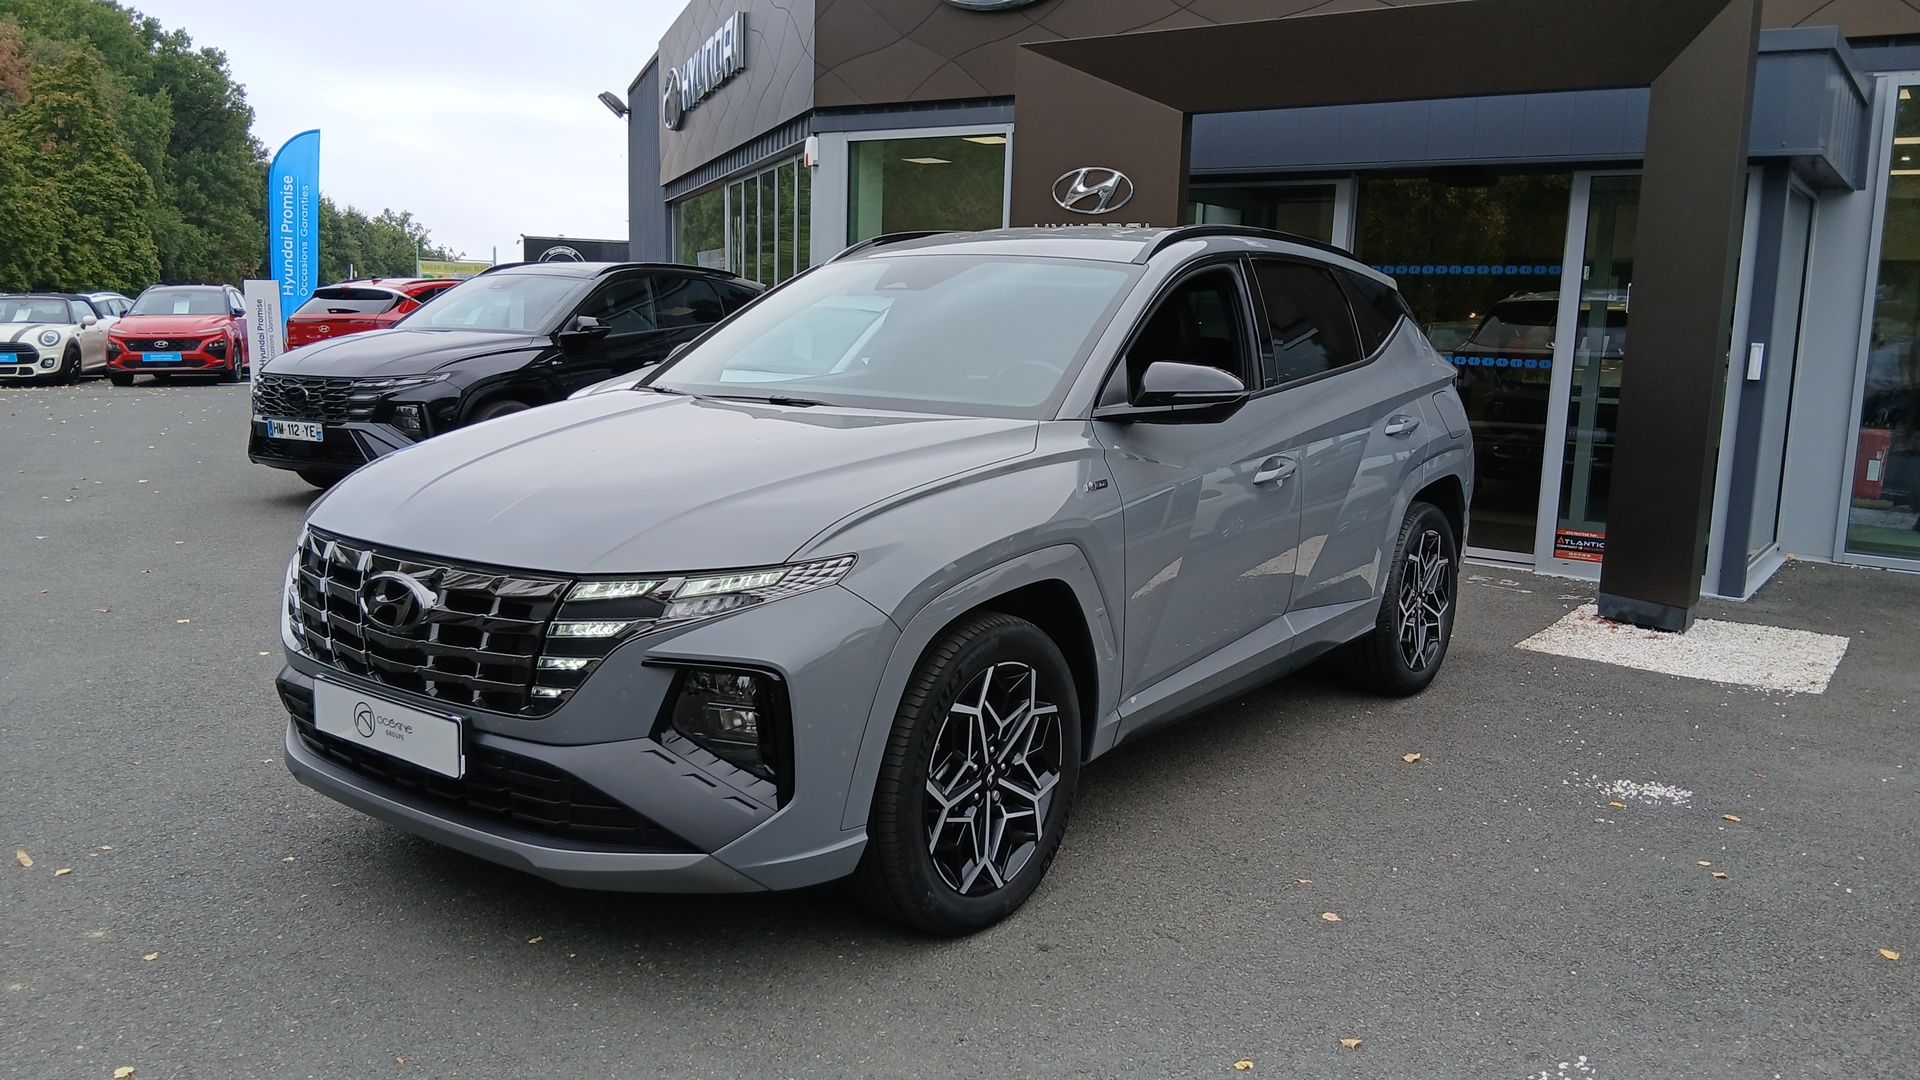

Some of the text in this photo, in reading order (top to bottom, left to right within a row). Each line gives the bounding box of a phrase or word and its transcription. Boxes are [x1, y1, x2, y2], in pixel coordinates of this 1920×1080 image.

[682, 10, 744, 111] HYUNDAI
[280, 175, 296, 296] Hyundai Promise
[300, 185, 309, 297] Occasions Garanties
[256, 298, 267, 366] Hyundai Promise
[1557, 536, 1605, 548] ATLANTIC
